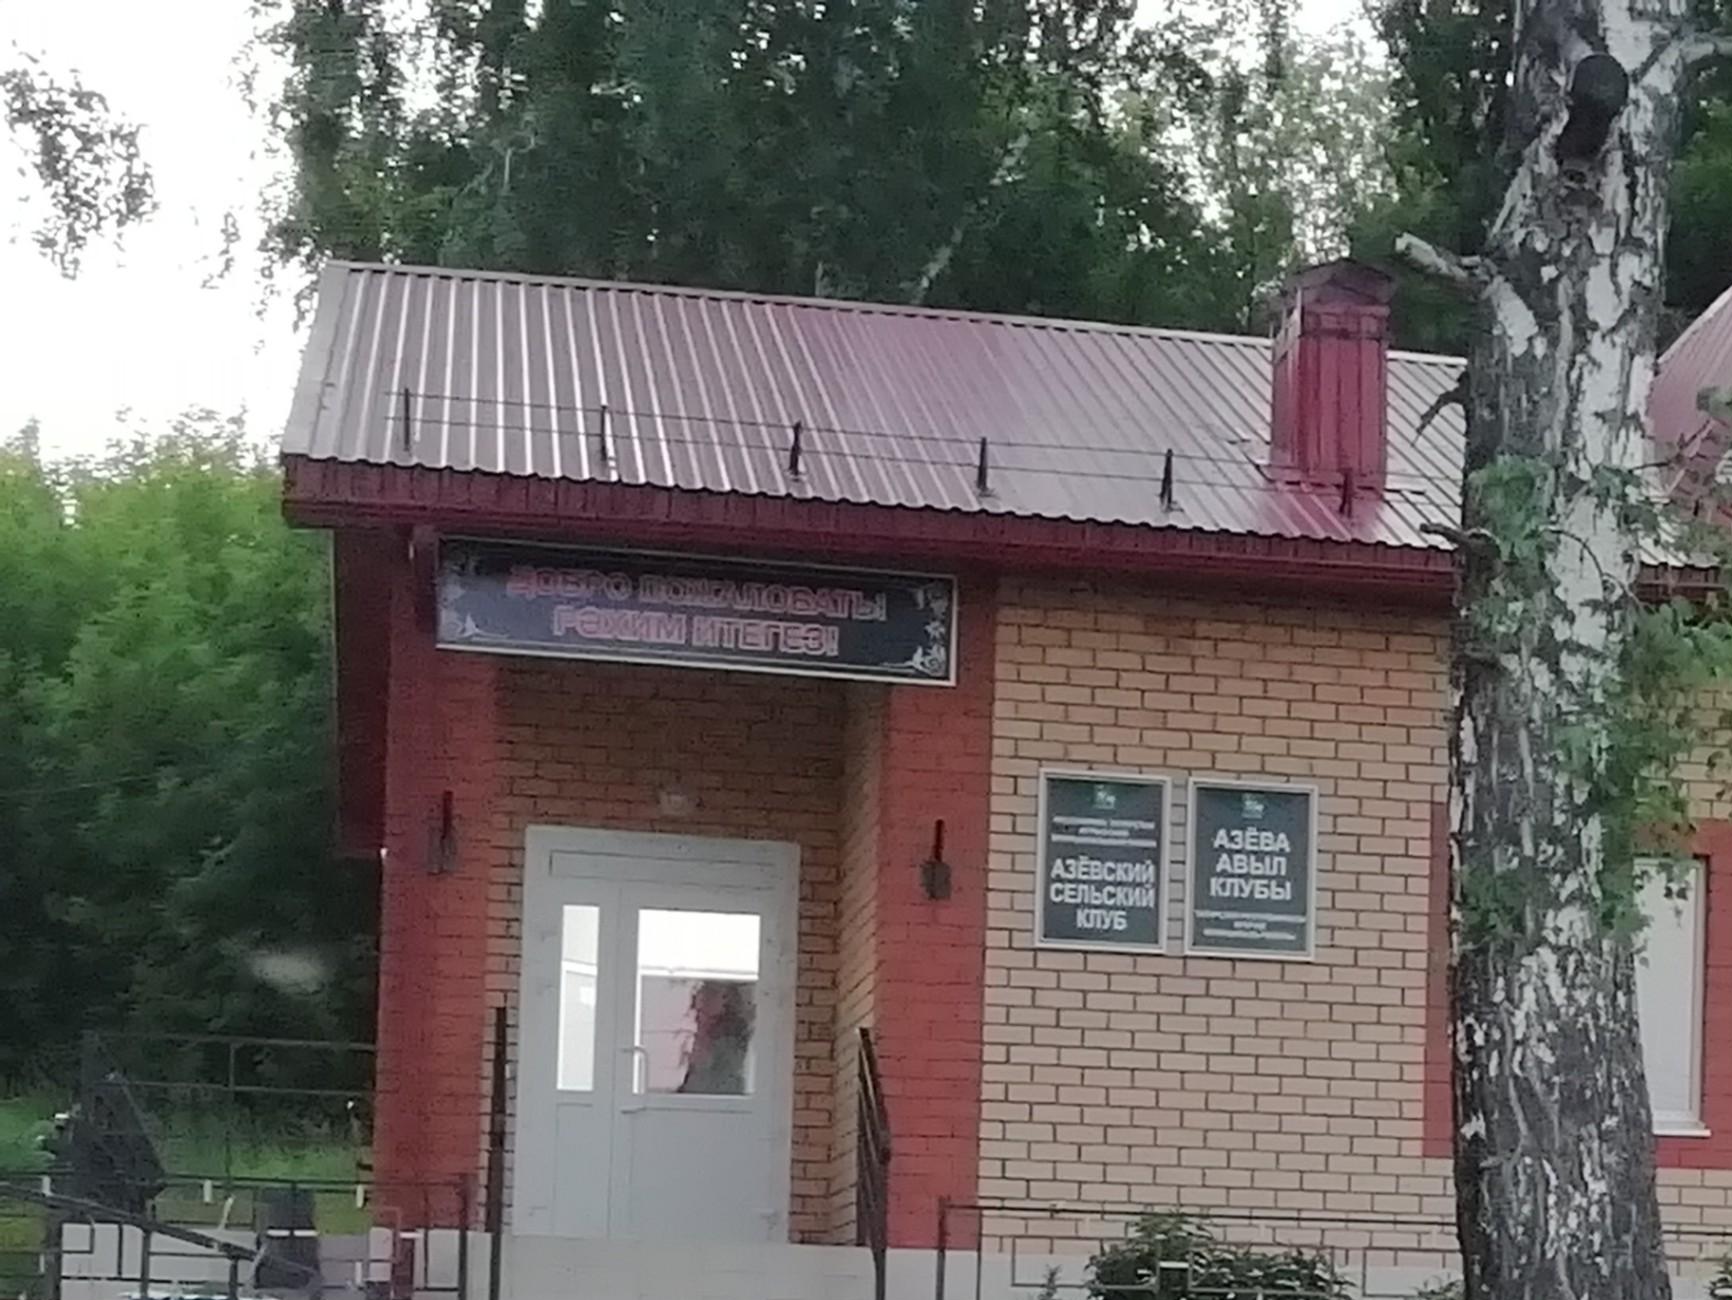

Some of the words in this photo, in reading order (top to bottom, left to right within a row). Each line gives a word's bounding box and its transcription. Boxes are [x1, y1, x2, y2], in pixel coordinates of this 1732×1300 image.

[507, 566, 633, 601] ДОБРО
[1215, 853, 1287, 876] АВЫЛ
[1050, 882, 1155, 908] СЕЛЬСКИЙ
[1210, 877, 1292, 901] КЛУБЫ
[1076, 908, 1128, 931] КЛУБ
